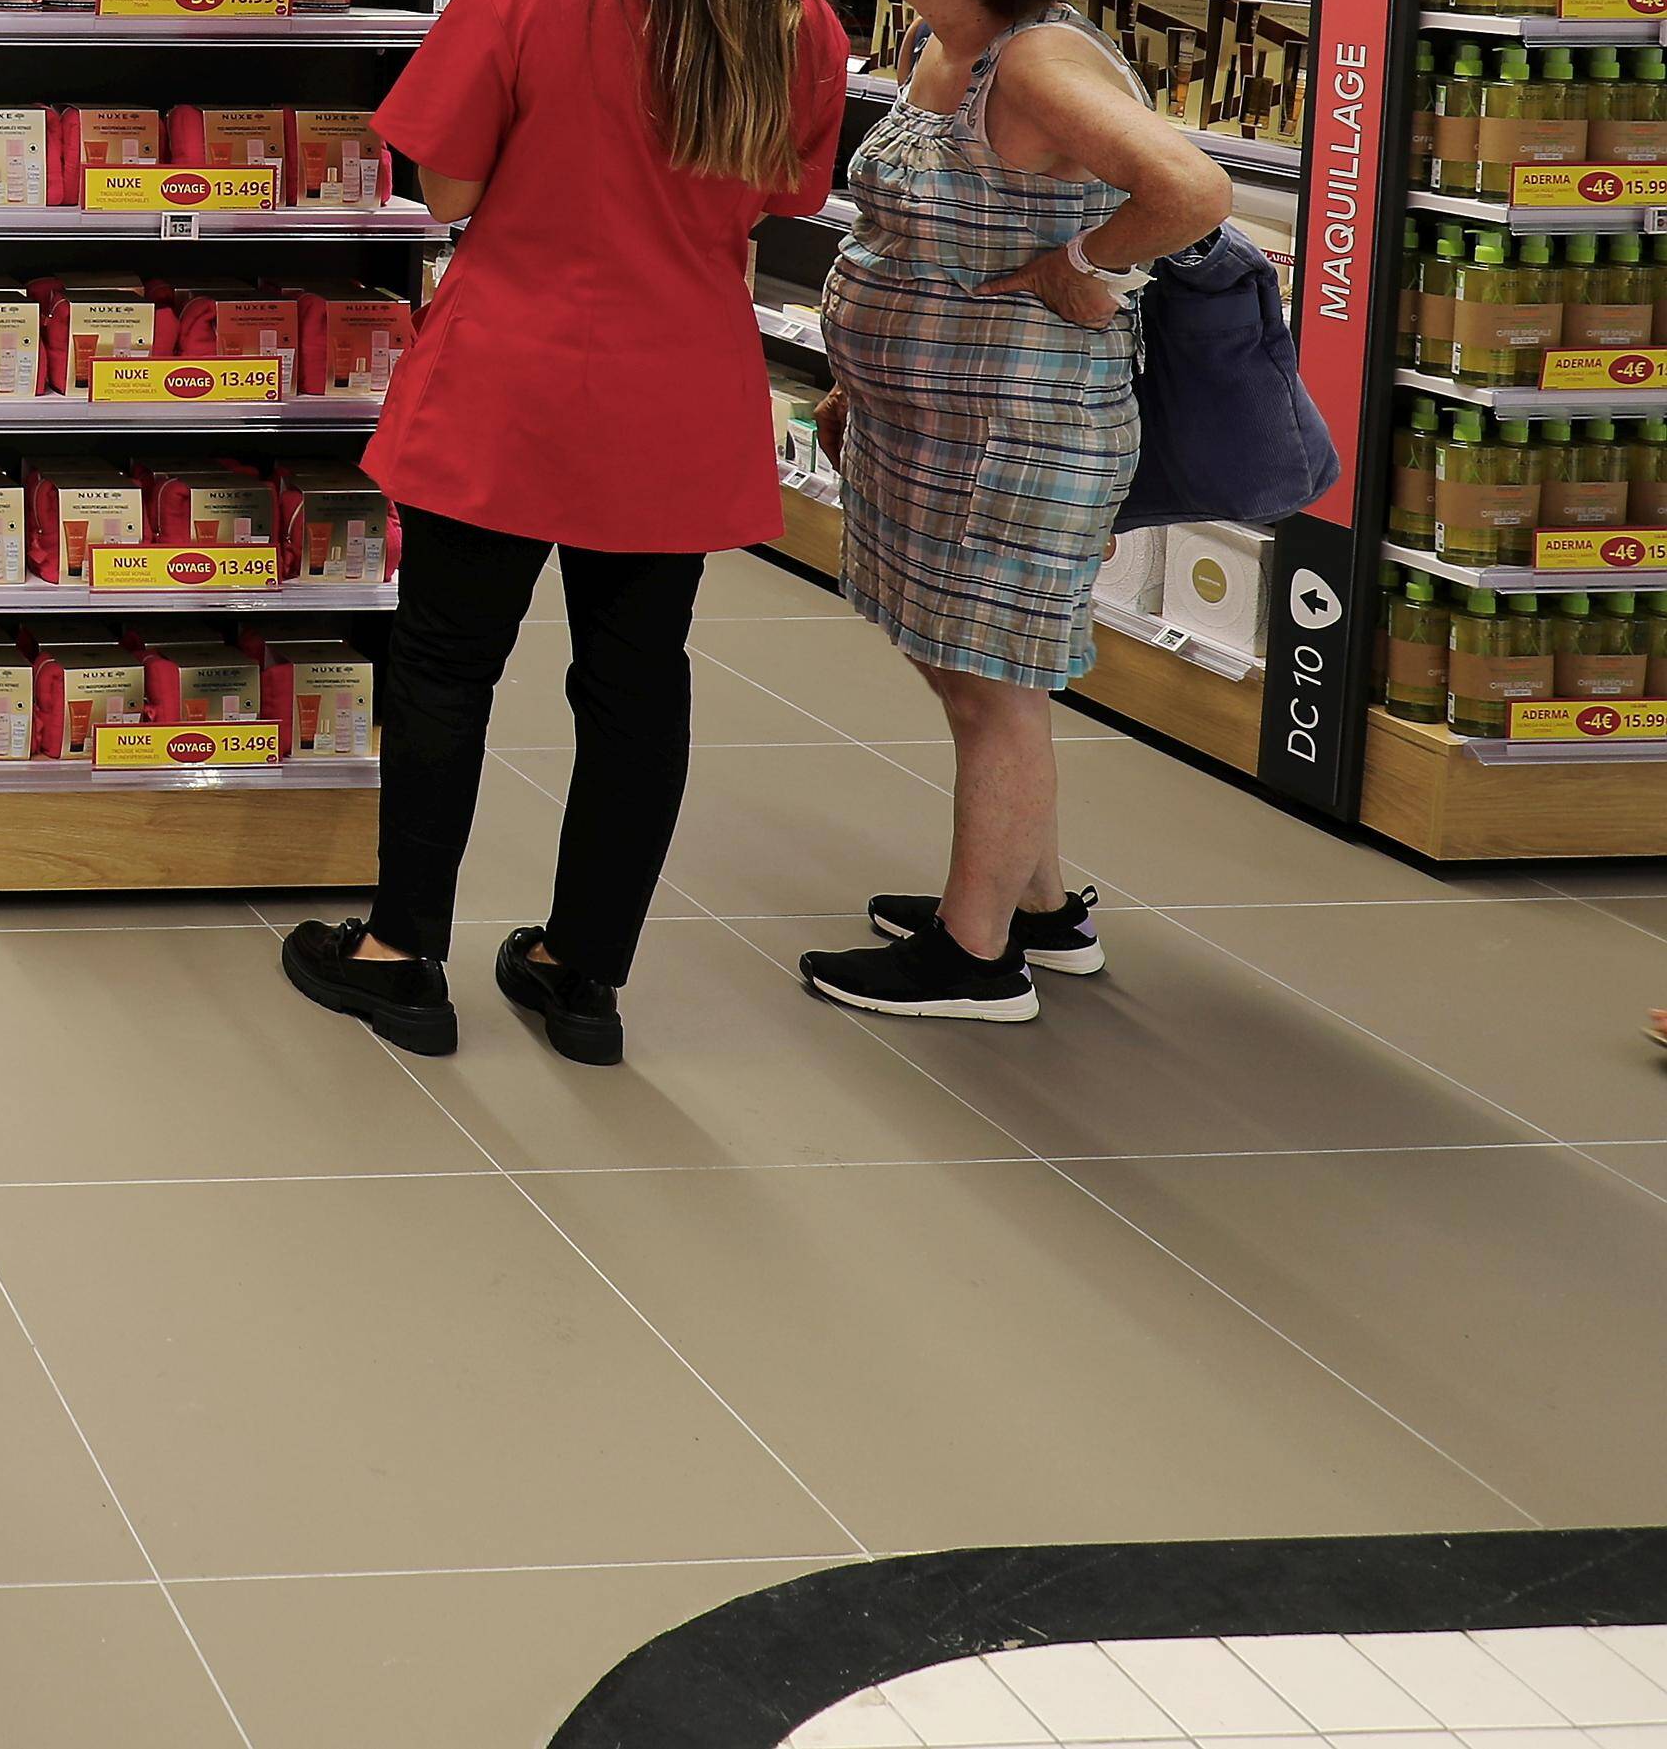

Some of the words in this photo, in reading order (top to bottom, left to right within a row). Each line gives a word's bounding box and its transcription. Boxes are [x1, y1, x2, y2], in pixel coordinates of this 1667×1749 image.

[106, 178, 141, 189] NUXE
[161, 183, 206, 194] VOYAGE
[214, 181, 270, 196] 13.49€
[1319, 43, 1367, 322] MAQUILLAGE
[1523, 175, 1571, 184] ADERMA
[1586, 179, 1615, 195] -4€
[1555, 358, 1603, 368] ADERMA
[1617, 362, 1646, 377] -4€
[114, 369, 149, 380] NUXE
[167, 376, 212, 389] VOYAGE
[219, 370, 276, 388] 13.49€
[1545, 540, 1593, 550] ADERMA
[1608, 544, 1637, 559] -4€
[113, 557, 148, 568] NUXE
[167, 563, 211, 573] VOYAGE
[219, 559, 275, 575] 13.49€
[1292, 645, 1324, 689] 10
[1521, 709, 1569, 720] ADERMA
[1584, 713, 1612, 729] -4€
[1287, 697, 1322, 763] DC
[117, 735, 152, 746] NUXE
[169, 742, 213, 753] VOYAGE
[221, 736, 276, 752] 13.49€
